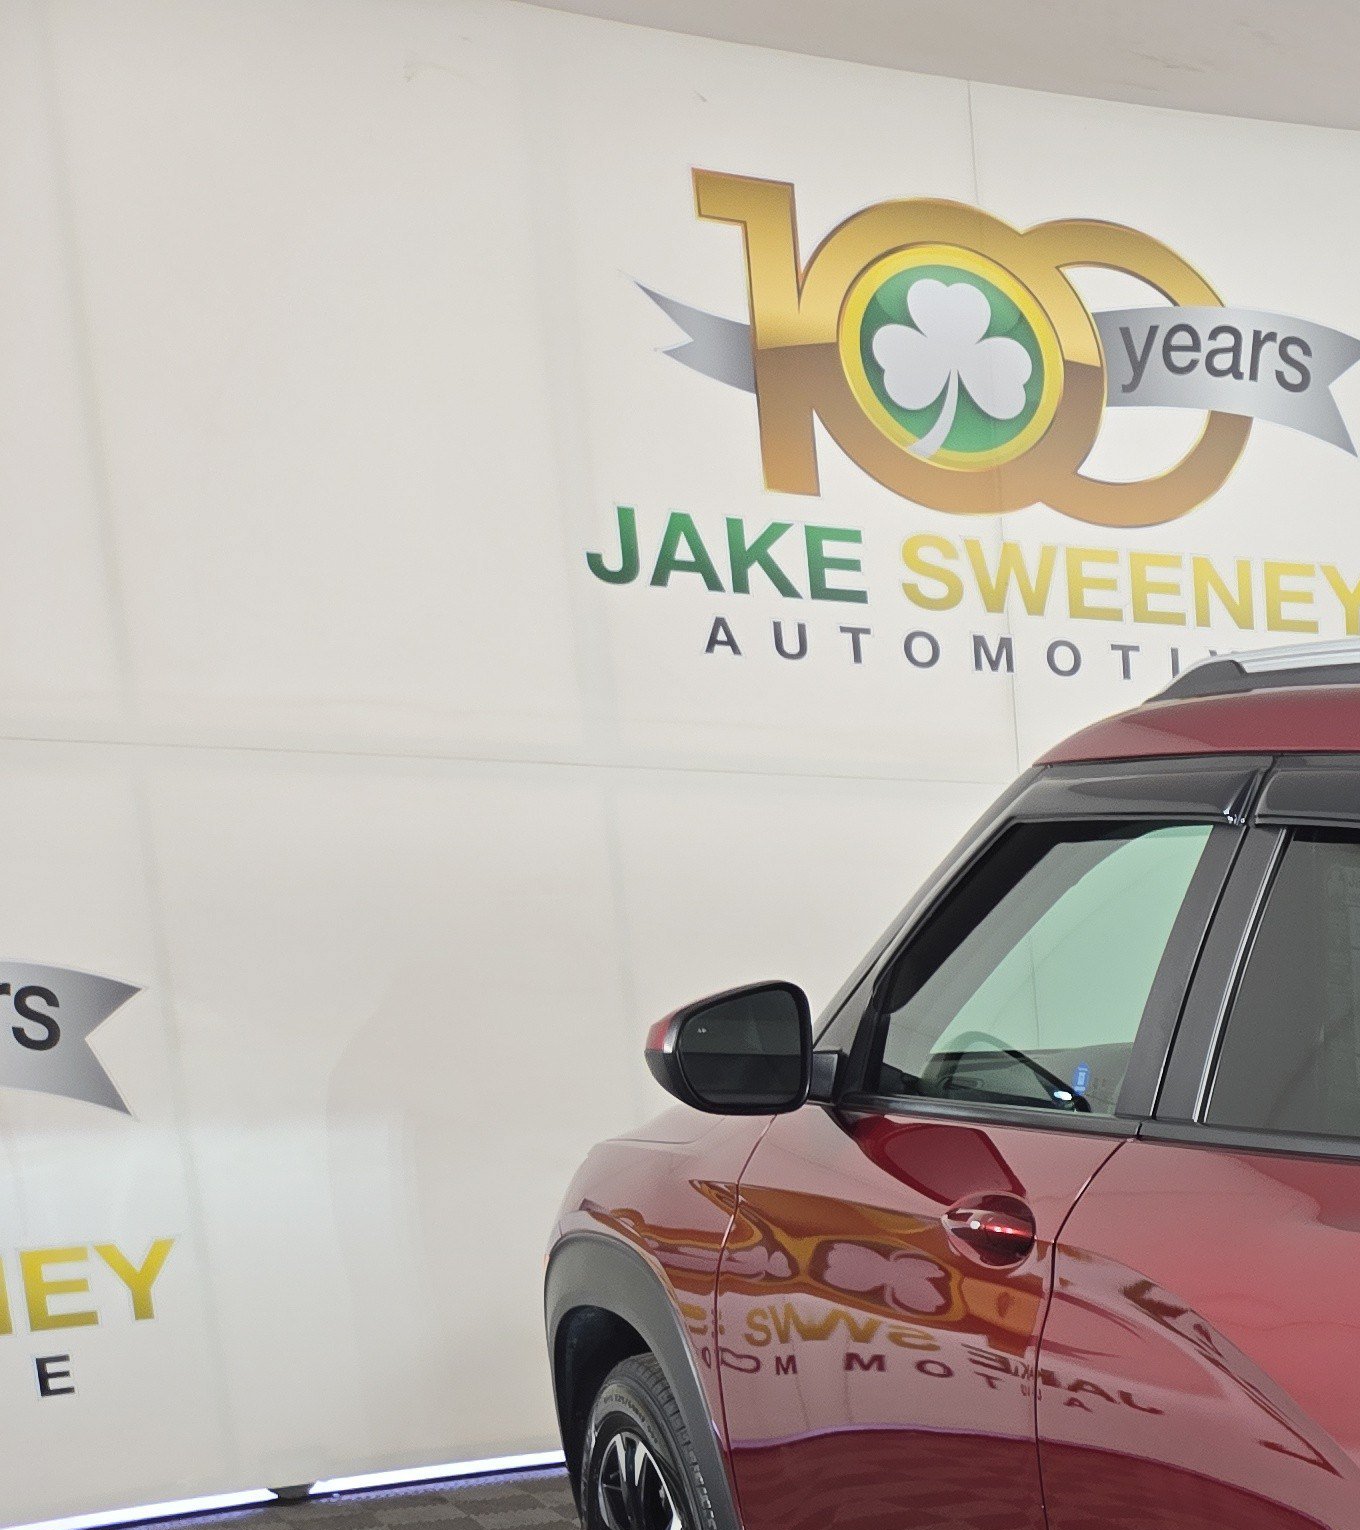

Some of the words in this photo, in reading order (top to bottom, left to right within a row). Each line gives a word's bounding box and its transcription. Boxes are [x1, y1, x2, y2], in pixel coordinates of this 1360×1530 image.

[1119, 323, 1314, 393] years
[586, 506, 868, 603] JAKE
[705, 616, 1218, 681] AUTOMOTI
